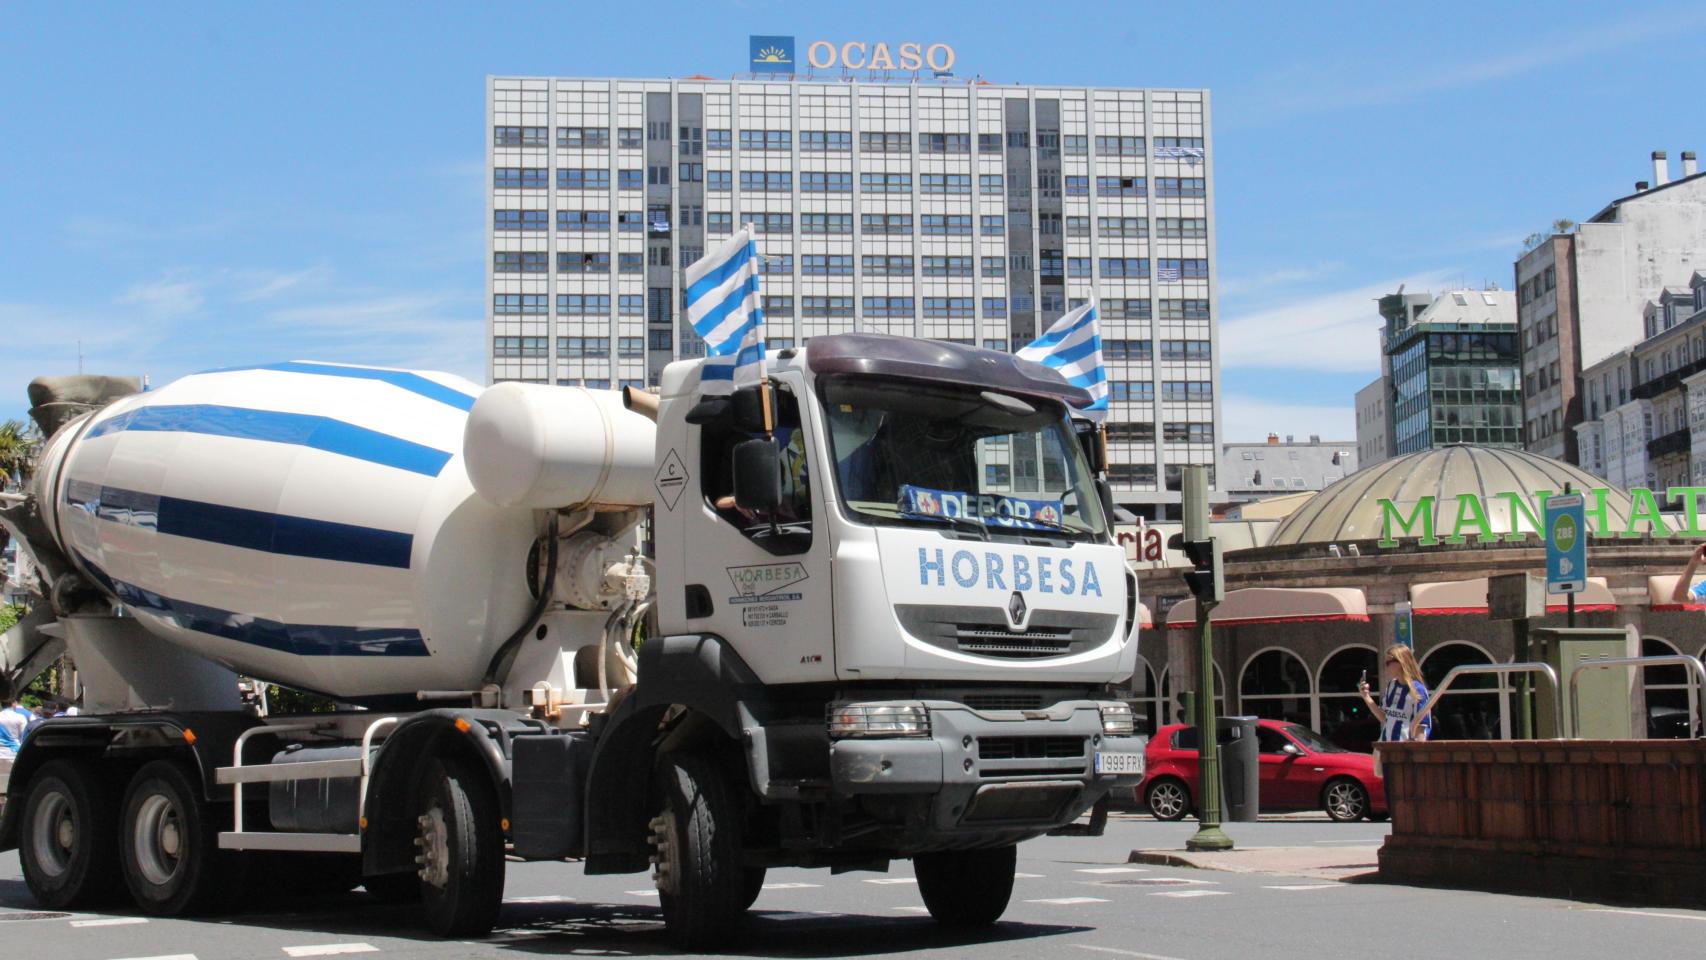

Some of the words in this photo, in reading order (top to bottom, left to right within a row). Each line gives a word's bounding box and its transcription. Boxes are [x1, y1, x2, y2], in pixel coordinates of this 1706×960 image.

[808, 41, 955, 71] OCASO
[668, 463, 675, 475] C
[941, 494, 1035, 529] DEPOR
[1556, 527, 1573, 540] ZBE
[734, 567, 801, 583] HORBESA
[918, 547, 1102, 597] HORBESA
[1102, 755, 1124, 771] 1999
